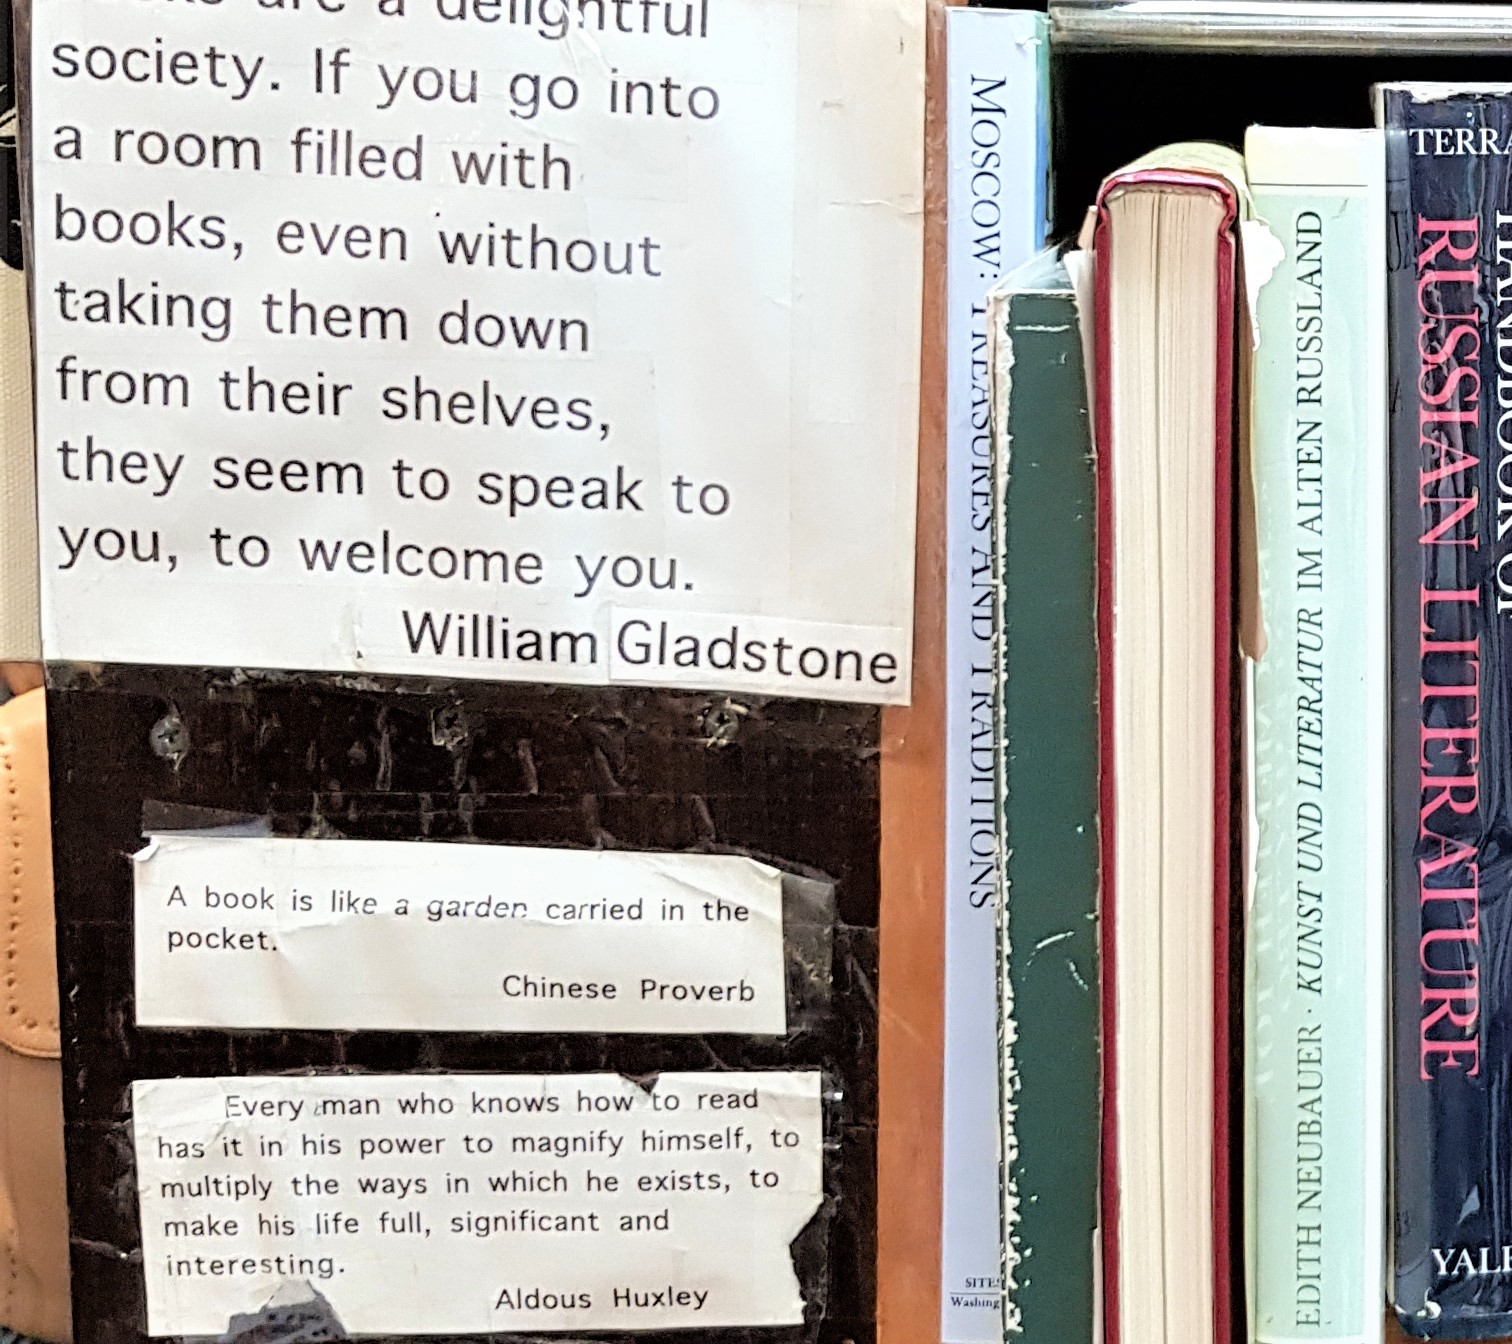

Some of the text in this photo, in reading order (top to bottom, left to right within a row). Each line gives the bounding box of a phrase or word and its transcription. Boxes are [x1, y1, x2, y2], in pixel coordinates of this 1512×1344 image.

[402, 611, 900, 684] William Gladstone
[1418, 214, 1481, 1080] RUSSIAN LITERATURE
[167, 885, 186, 908] A
[205, 886, 274, 911] book
[293, 890, 312, 912] is
[331, 890, 377, 915] like
[395, 897, 408, 916] a
[545, 899, 642, 921] carried
[661, 899, 685, 921] in
[703, 900, 750, 921] the
[168, 929, 278, 953] pocket.
[503, 976, 755, 1002] Chinese Proverb
[1295, 1024, 1322, 1328] EDITH NEUBAUER
[495, 1285, 709, 1313] Aldous Huxley
